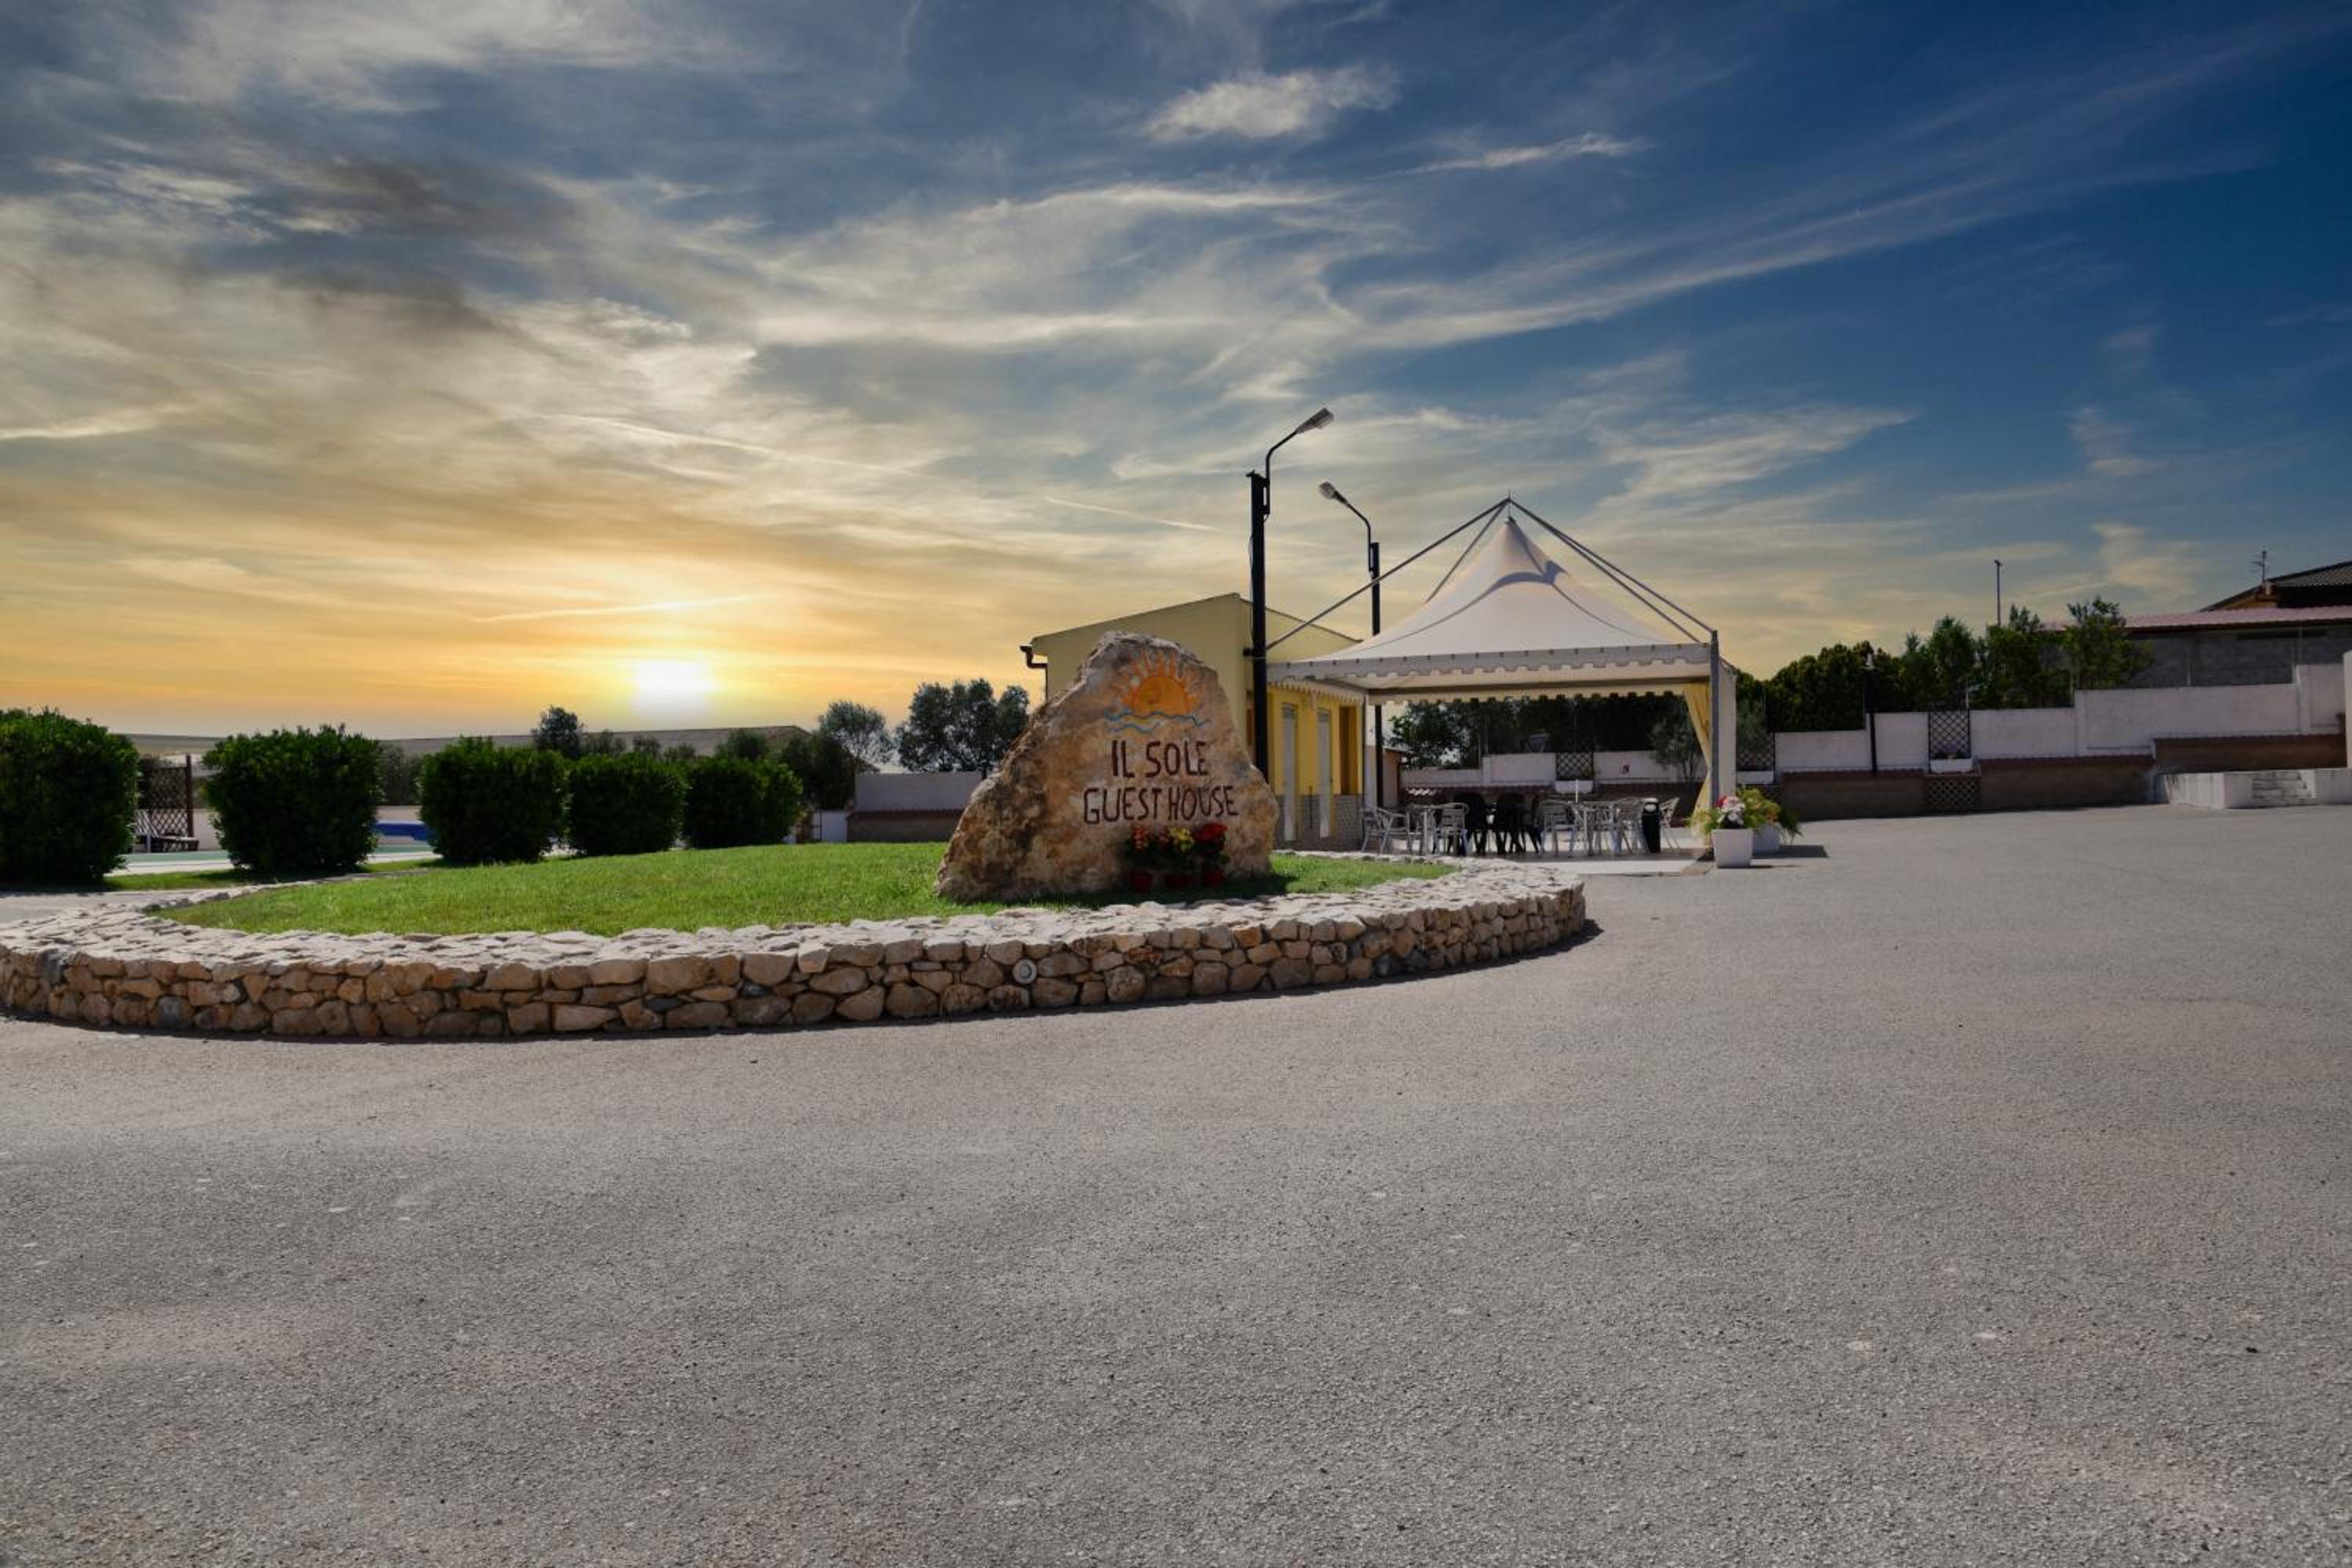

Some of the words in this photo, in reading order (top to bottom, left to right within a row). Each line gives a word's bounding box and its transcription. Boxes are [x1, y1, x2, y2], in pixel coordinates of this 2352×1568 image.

[1111, 739, 1134, 778] IL
[1145, 739, 1208, 778] SOLE
[1083, 786, 1162, 824] GUEST
[1167, 786, 1239, 821] HOUSE
